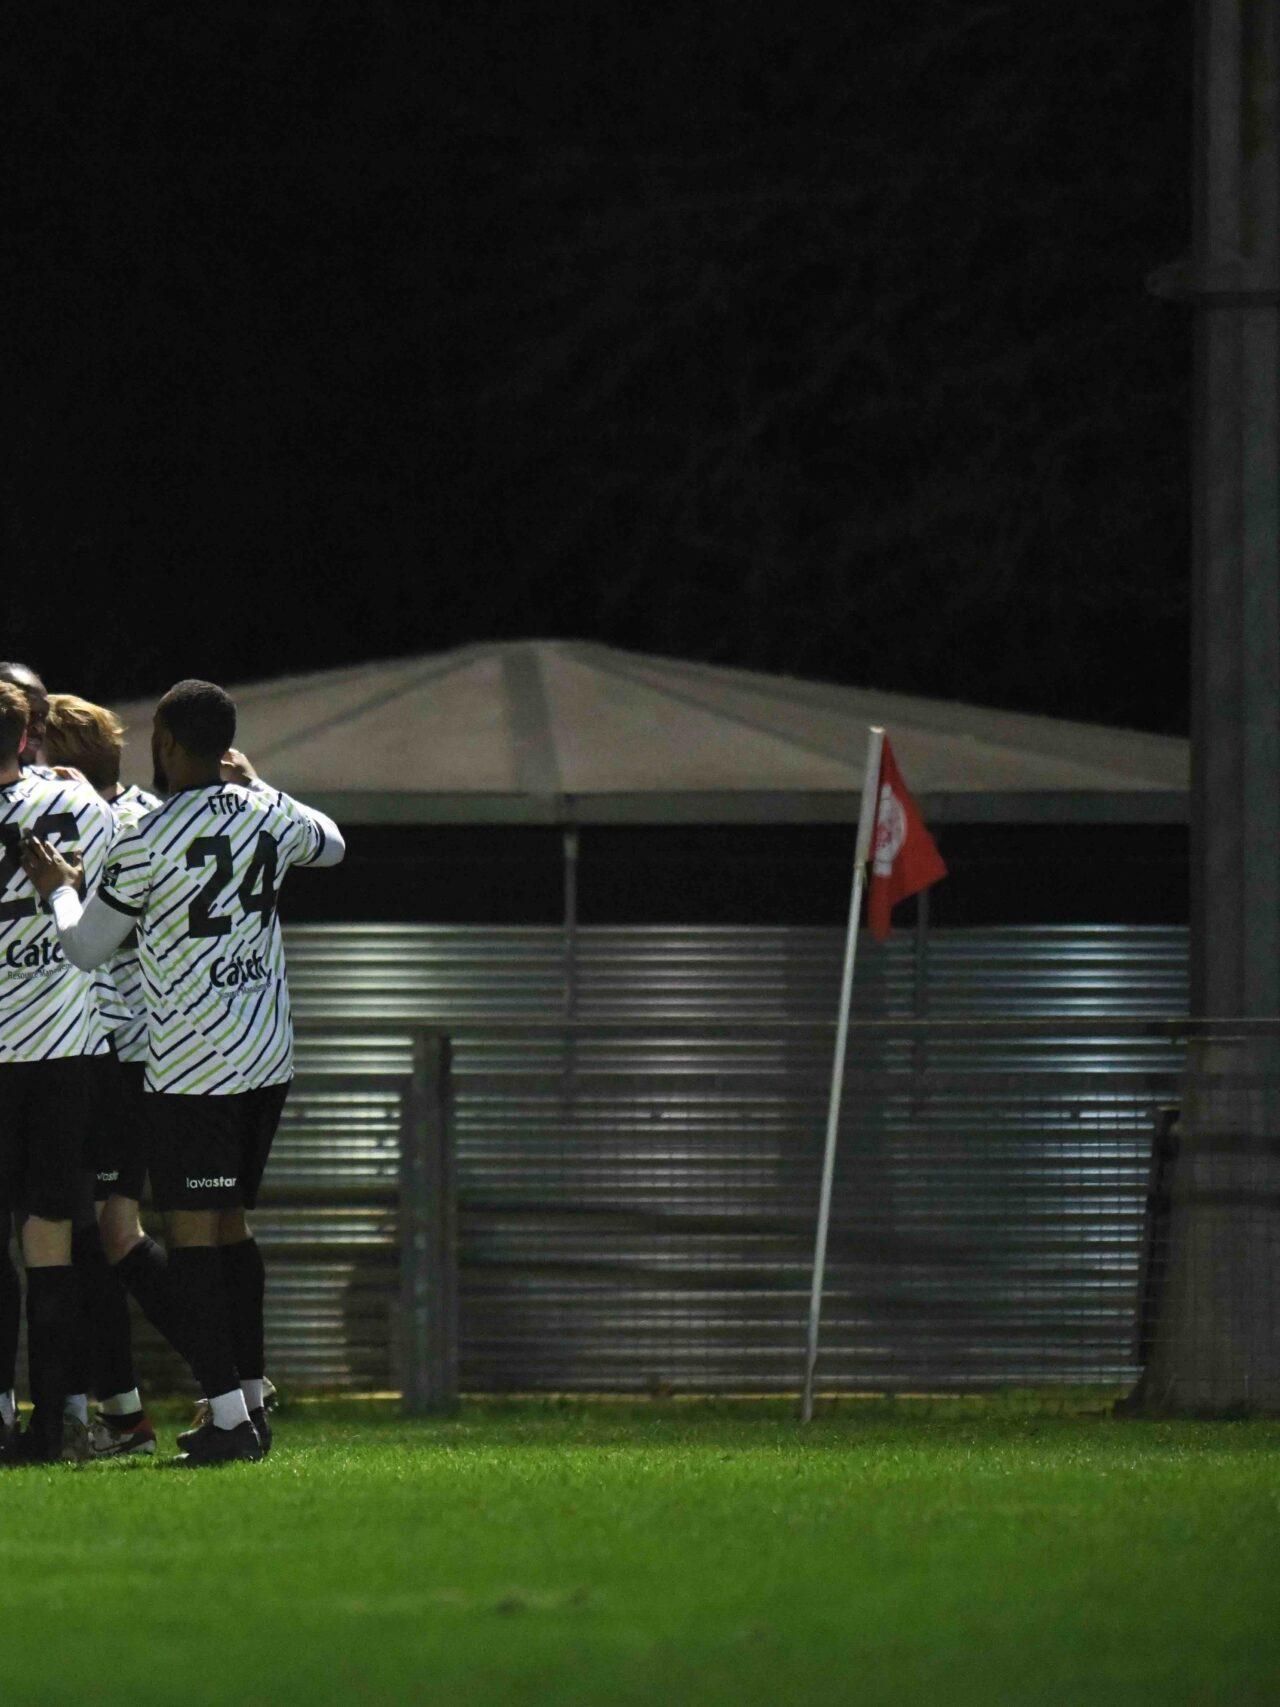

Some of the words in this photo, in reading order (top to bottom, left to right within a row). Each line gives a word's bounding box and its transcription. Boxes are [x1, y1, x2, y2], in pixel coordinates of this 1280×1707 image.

[186, 830, 278, 939] 24
[6, 937, 65, 968] Catc
[210, 949, 268, 987] Catch
[186, 1176, 236, 1189] lavastar
